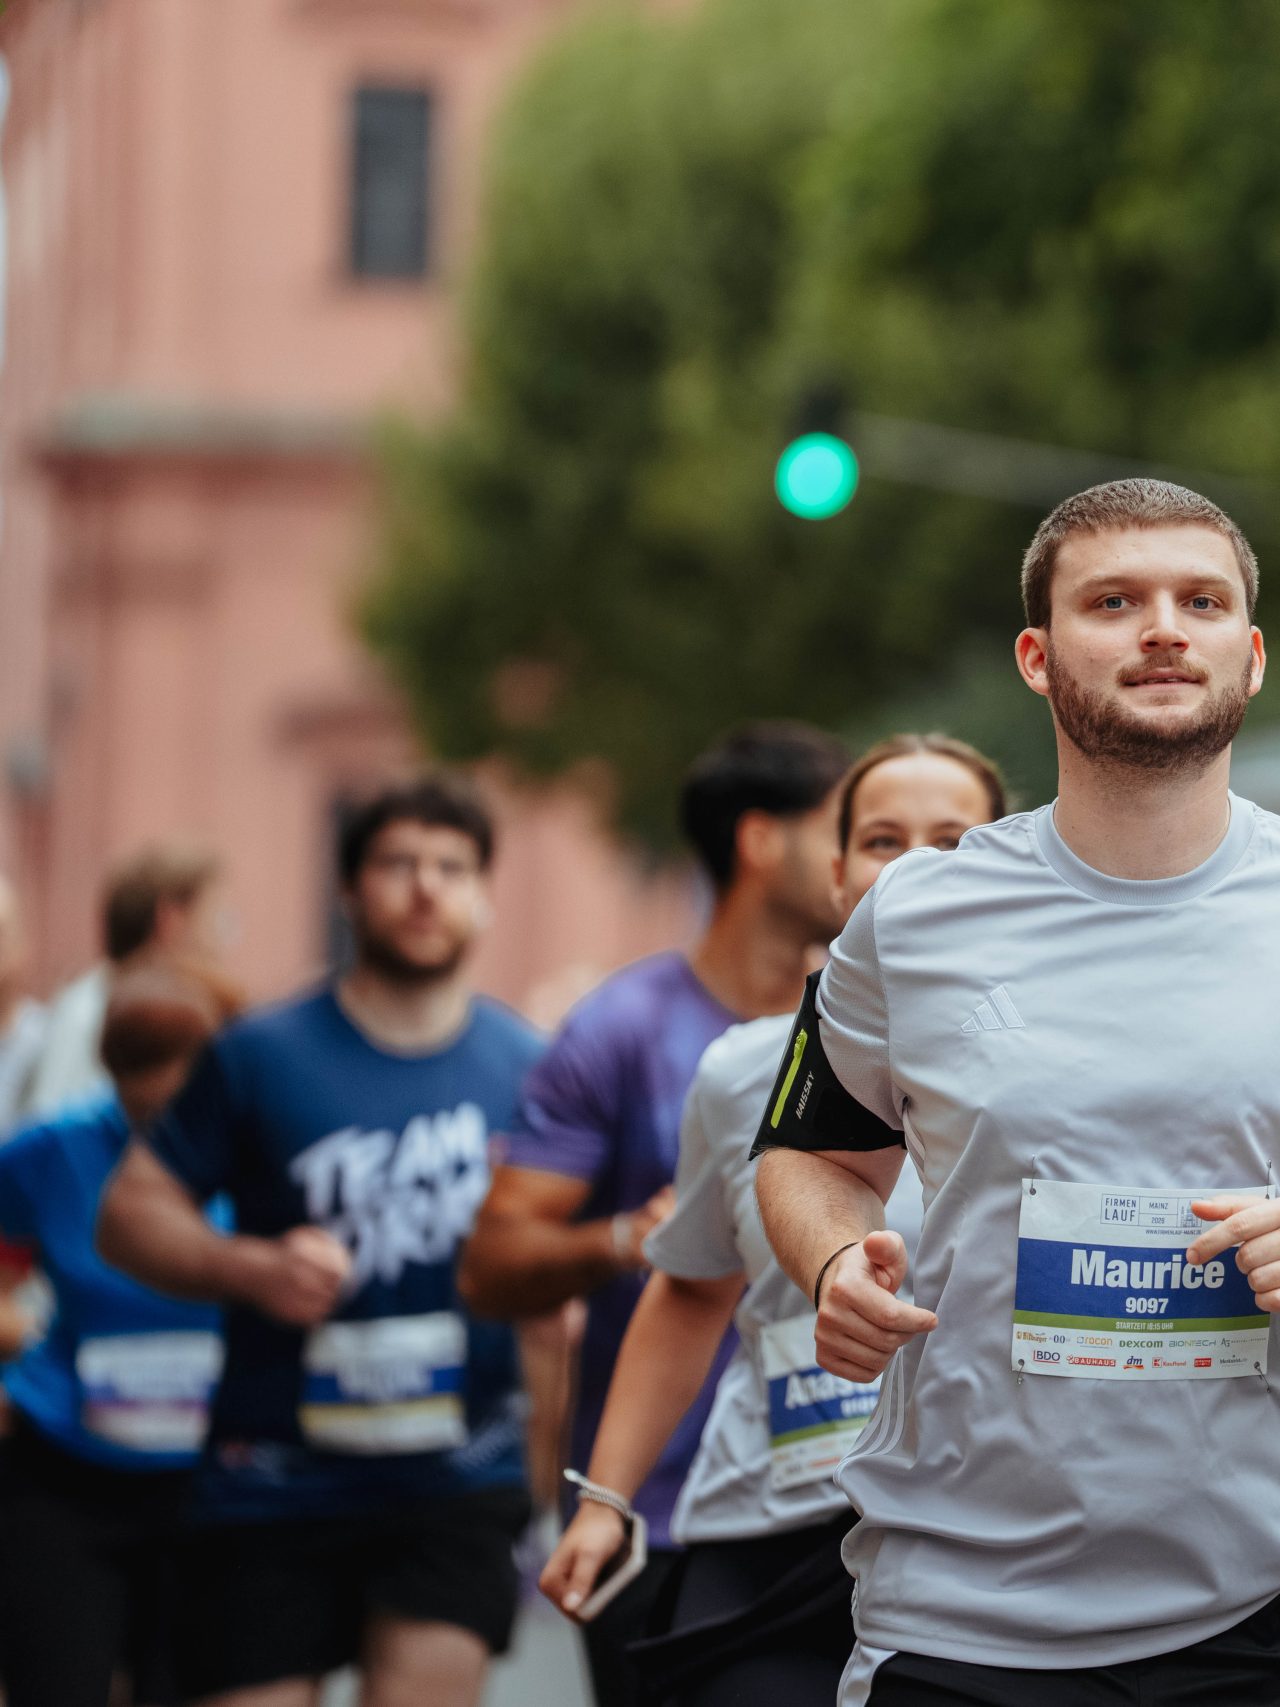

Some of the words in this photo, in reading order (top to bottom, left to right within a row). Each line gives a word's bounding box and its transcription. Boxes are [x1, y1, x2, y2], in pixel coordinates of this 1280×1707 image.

[1105, 1197, 1137, 1208] FIRMEN
[1148, 1202, 1169, 1210] MAINZ
[1104, 1207, 1136, 1222] LAUF
[1070, 1248, 1225, 1289] Maurice
[1125, 1297, 1169, 1314] 9097
[1115, 1321, 1146, 1330] STARTZEIT
[1036, 1350, 1061, 1361] BDO
[1074, 1356, 1116, 1366] BAUHAUS
[1126, 1355, 1143, 1365] dm
